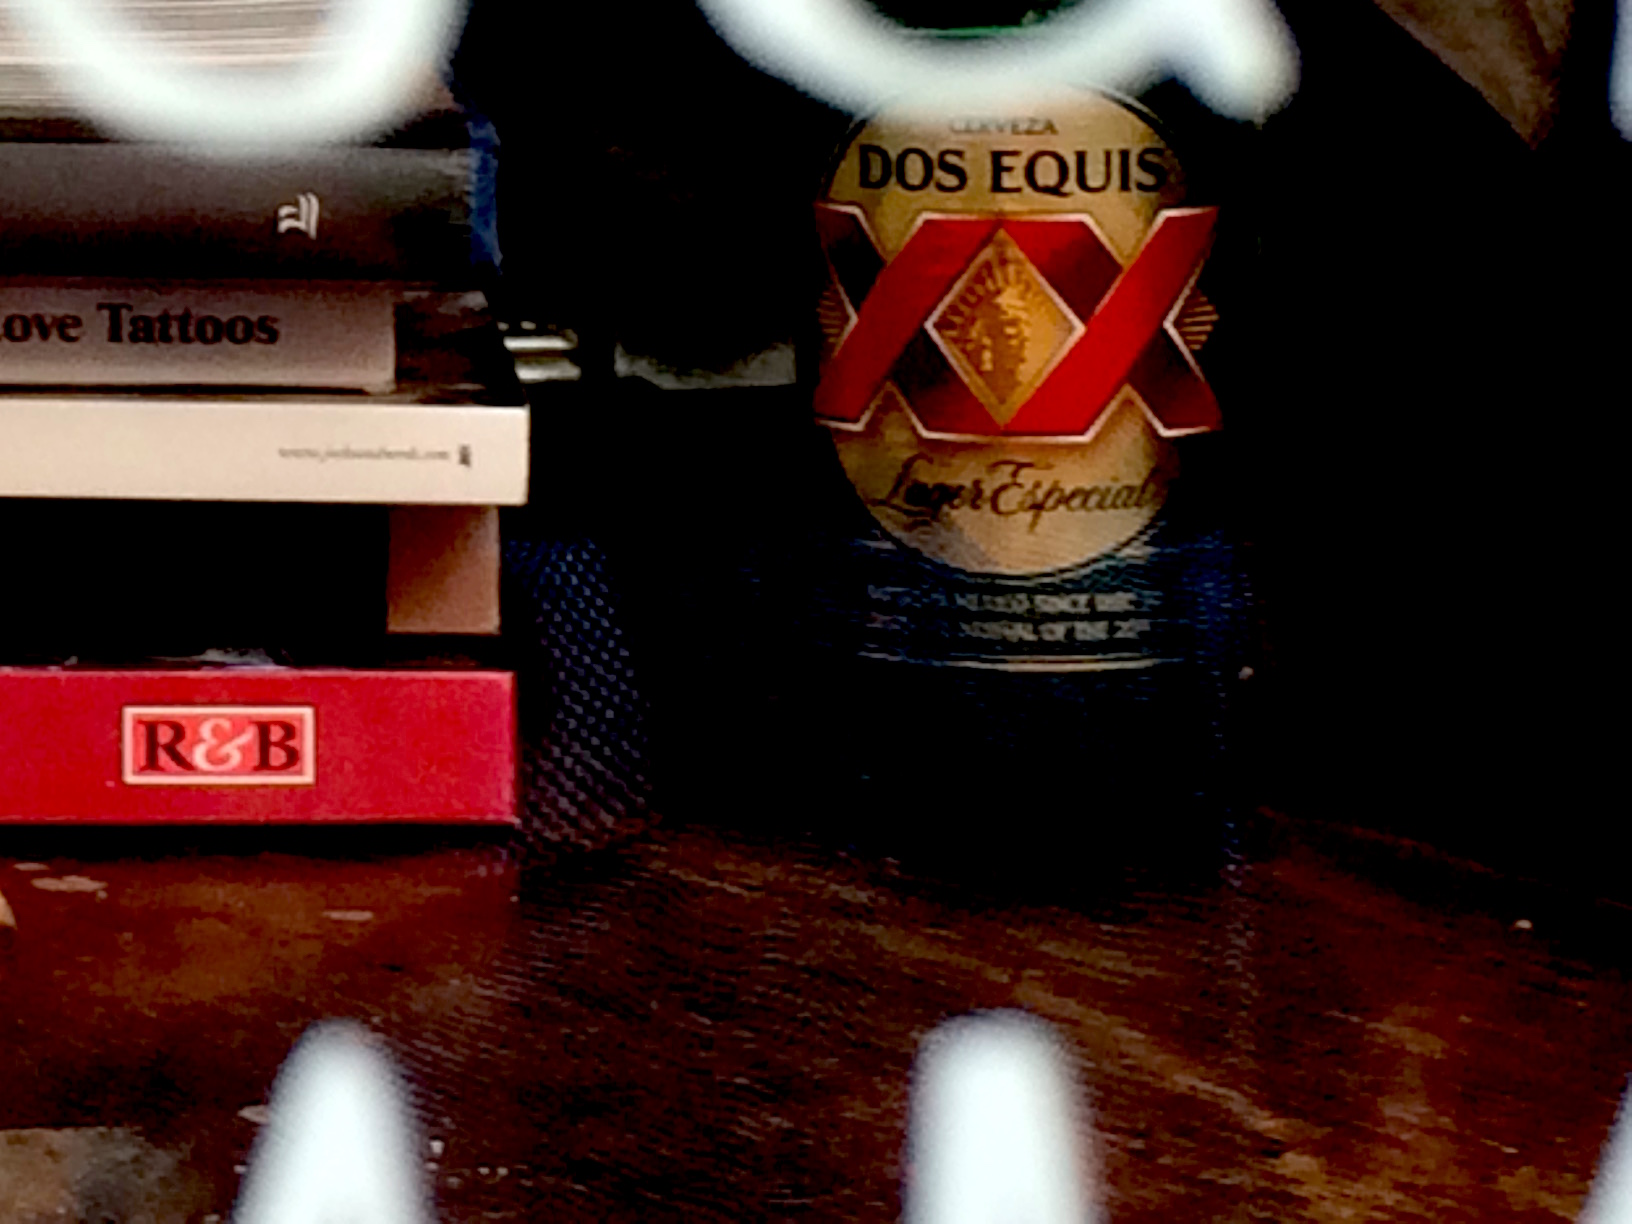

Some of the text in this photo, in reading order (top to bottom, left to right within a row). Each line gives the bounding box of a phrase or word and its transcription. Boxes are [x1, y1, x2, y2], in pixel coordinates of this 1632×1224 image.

[858, 143, 1167, 198] DOS EQUIS
[95, 302, 281, 347] Tattoos
[987, 459, 1164, 535] Especial
[136, 717, 302, 774] R&B
